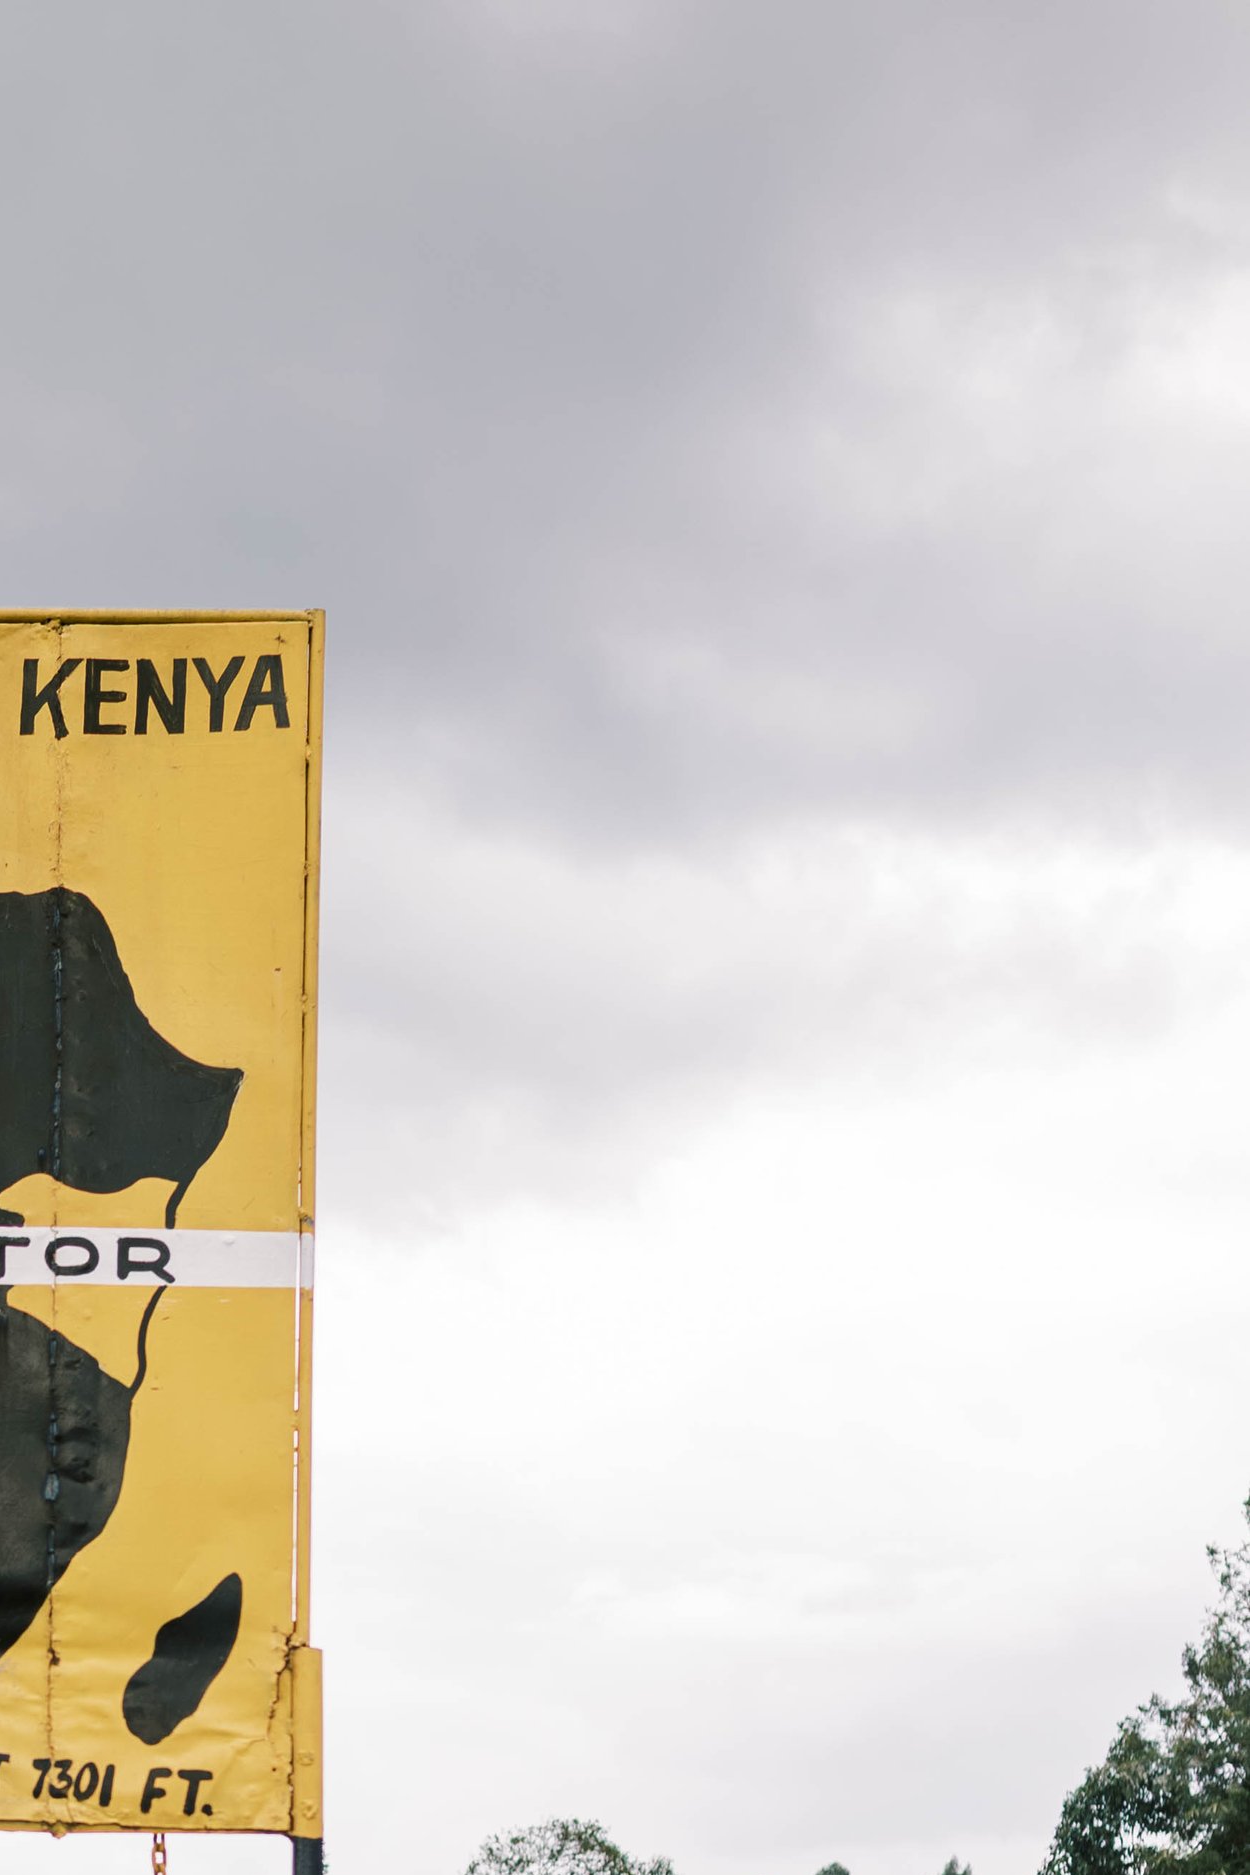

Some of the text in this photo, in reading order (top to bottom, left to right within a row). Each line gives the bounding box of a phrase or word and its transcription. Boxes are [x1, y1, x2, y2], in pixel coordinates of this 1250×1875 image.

[20, 655, 290, 740] KENYA
[33, 1759, 115, 1807] 7301
[141, 1767, 213, 1817] FT.
